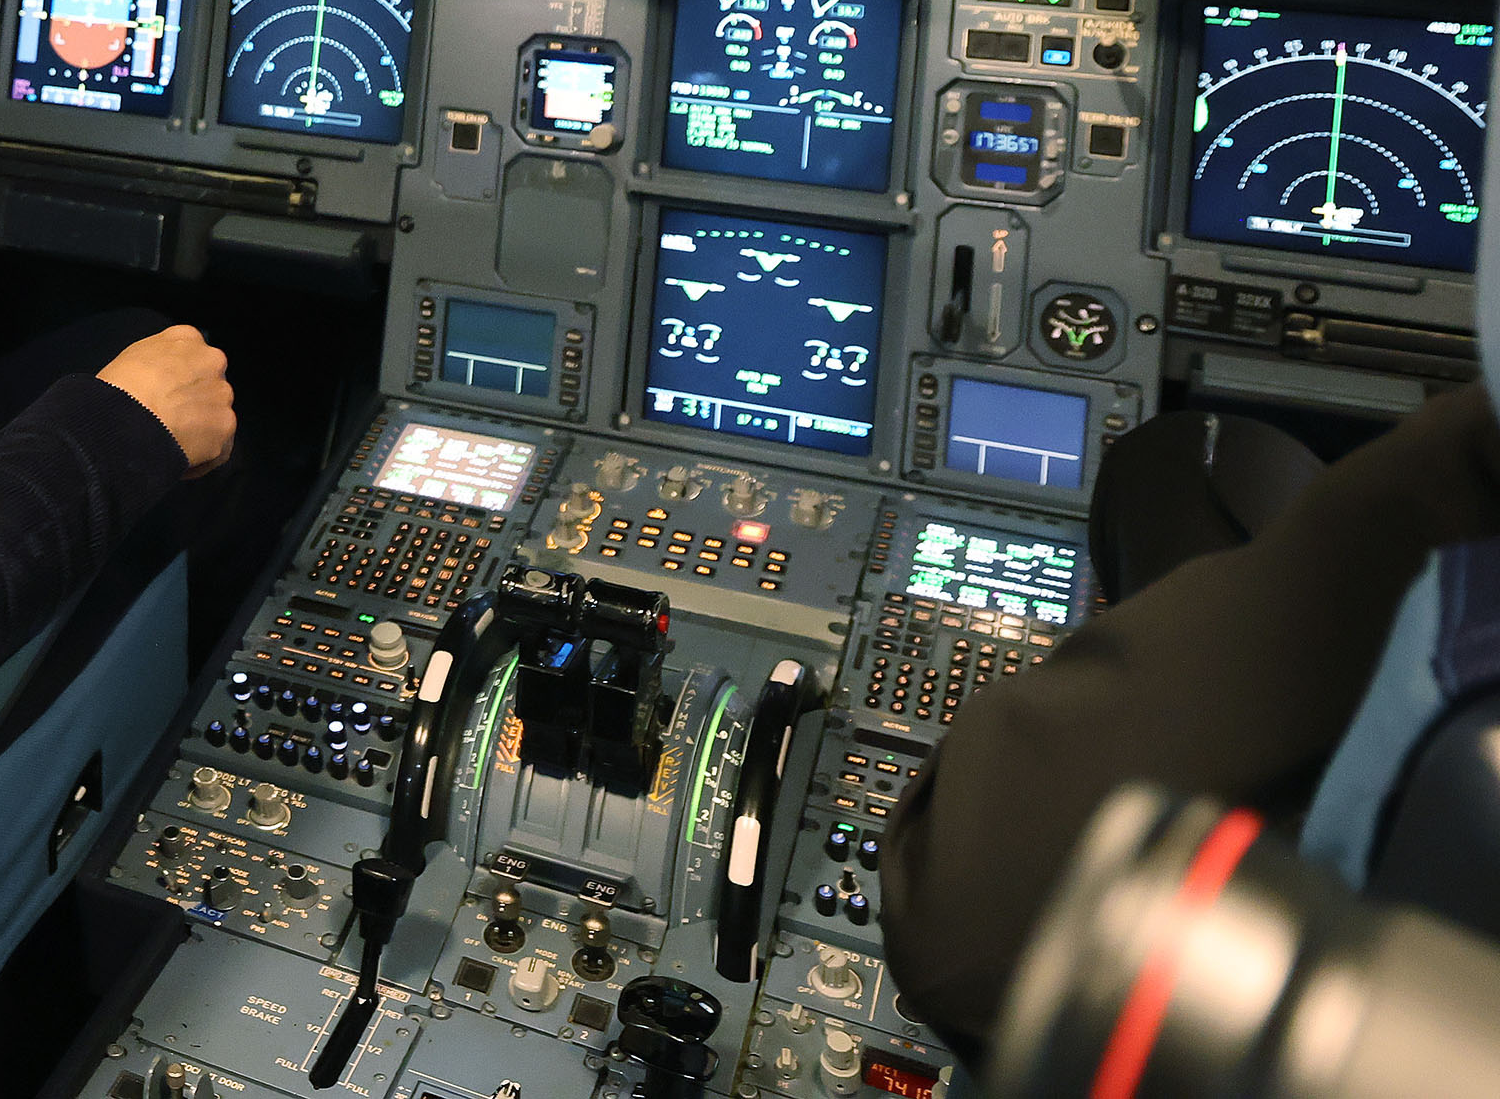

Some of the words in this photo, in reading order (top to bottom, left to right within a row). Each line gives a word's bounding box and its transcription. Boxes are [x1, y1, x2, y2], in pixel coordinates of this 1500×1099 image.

[496, 854, 526, 870] ENG
[585, 880, 616, 896] ENG
[541, 918, 568, 933] ENG
[535, 948, 559, 960] MODE
[864, 956, 882, 968] LT
[465, 992, 471, 1001] 1
[246, 995, 288, 1015] SPEED
[239, 1005, 283, 1025] BRAKE
[384, 1009, 404, 1021] RET
[580, 1030, 589, 1040] 2
[275, 1056, 299, 1072] FULL
[218, 1075, 245, 1092] DOOR
[345, 1083, 370, 1098] FULL
